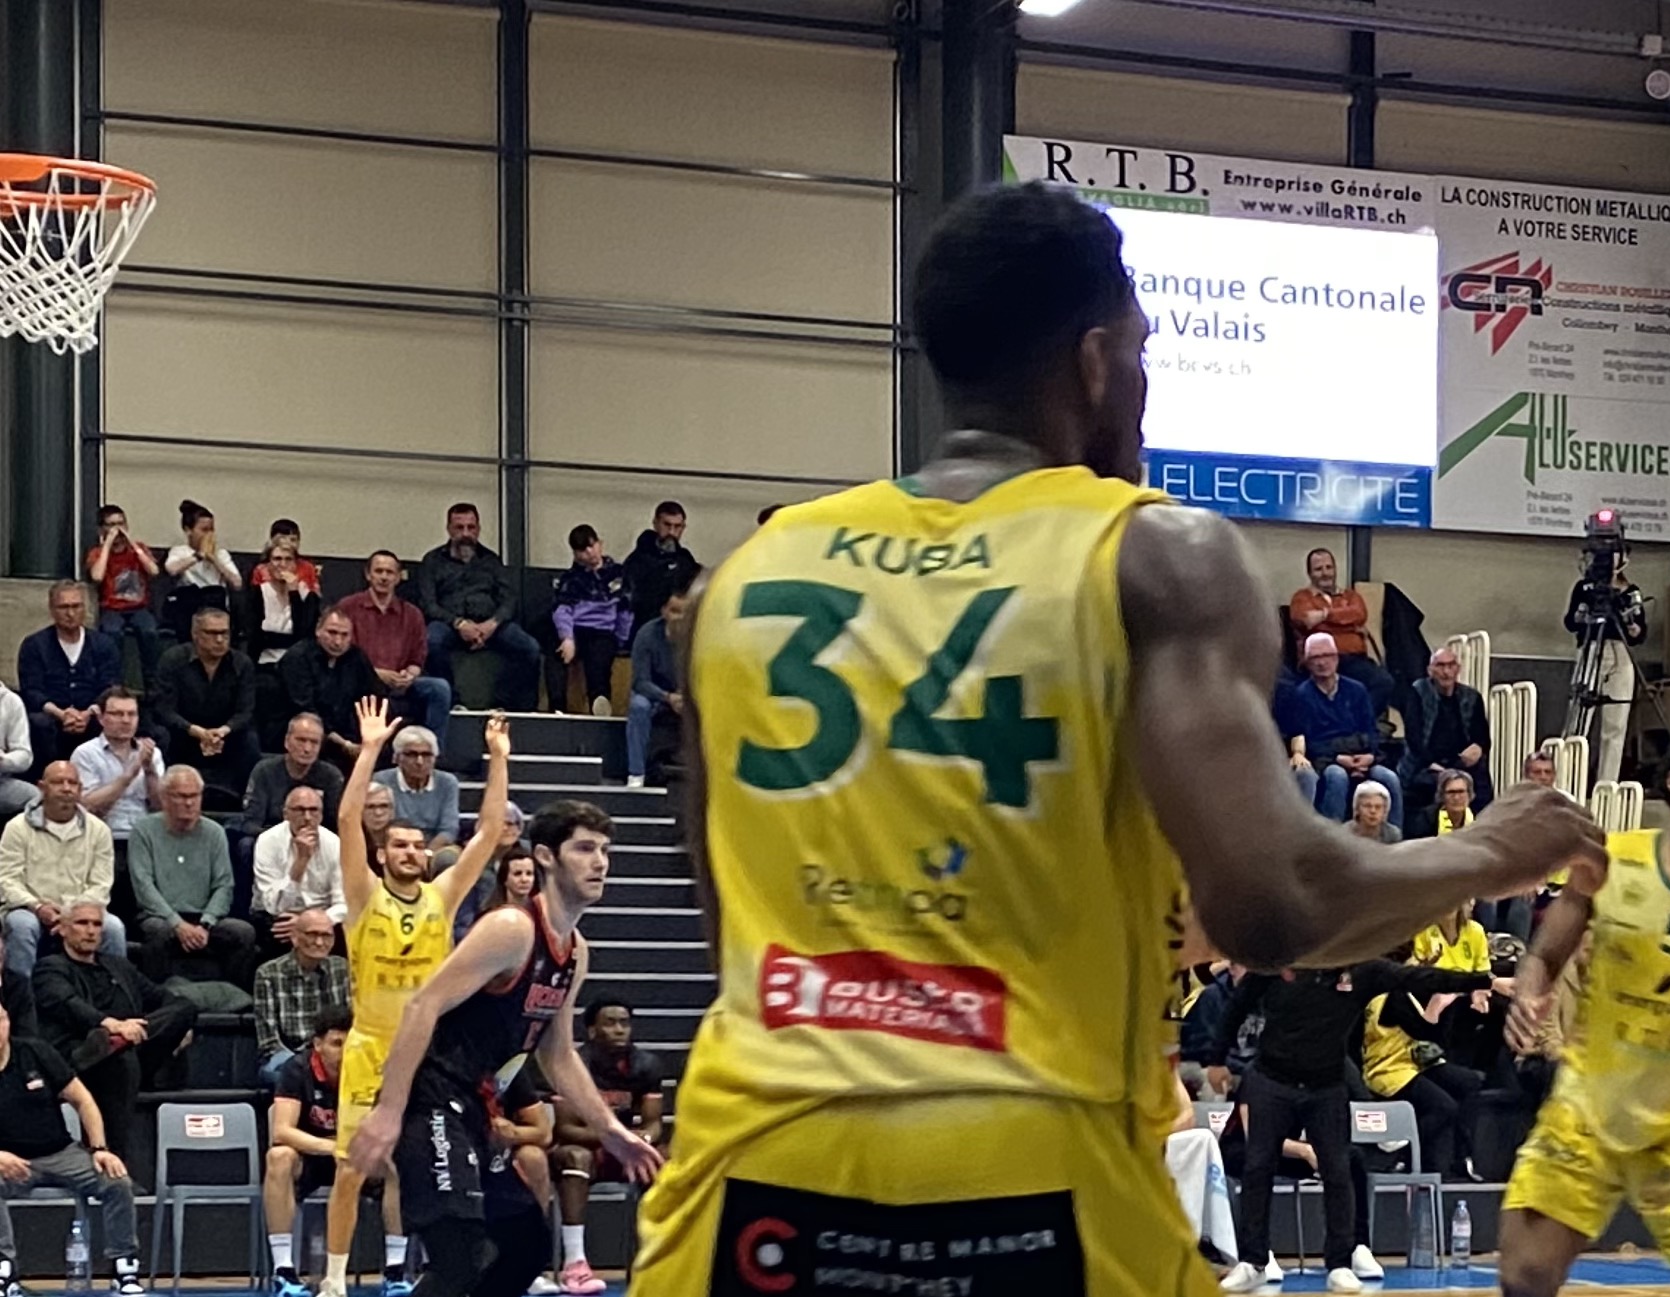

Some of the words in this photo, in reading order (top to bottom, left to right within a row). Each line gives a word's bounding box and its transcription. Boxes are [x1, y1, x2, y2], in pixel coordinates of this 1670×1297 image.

[1223, 169, 1324, 194] Entreprise
[1330, 179, 1423, 203] Générale
[1441, 186, 1462, 204] LA
[1466, 188, 1592, 217] CONSTRUCTION
[1240, 199, 1407, 225] www.villaRTB.ch
[1498, 218, 1510, 236] A
[1512, 219, 1568, 240] VOTRE
[1570, 223, 1639, 246] SERVICE
[1258, 275, 1427, 316] Cantonale
[1169, 308, 1267, 343] Valais
[823, 526, 993, 577] KUBA
[735, 579, 1060, 807] 34
[400, 912, 415, 936] 6
